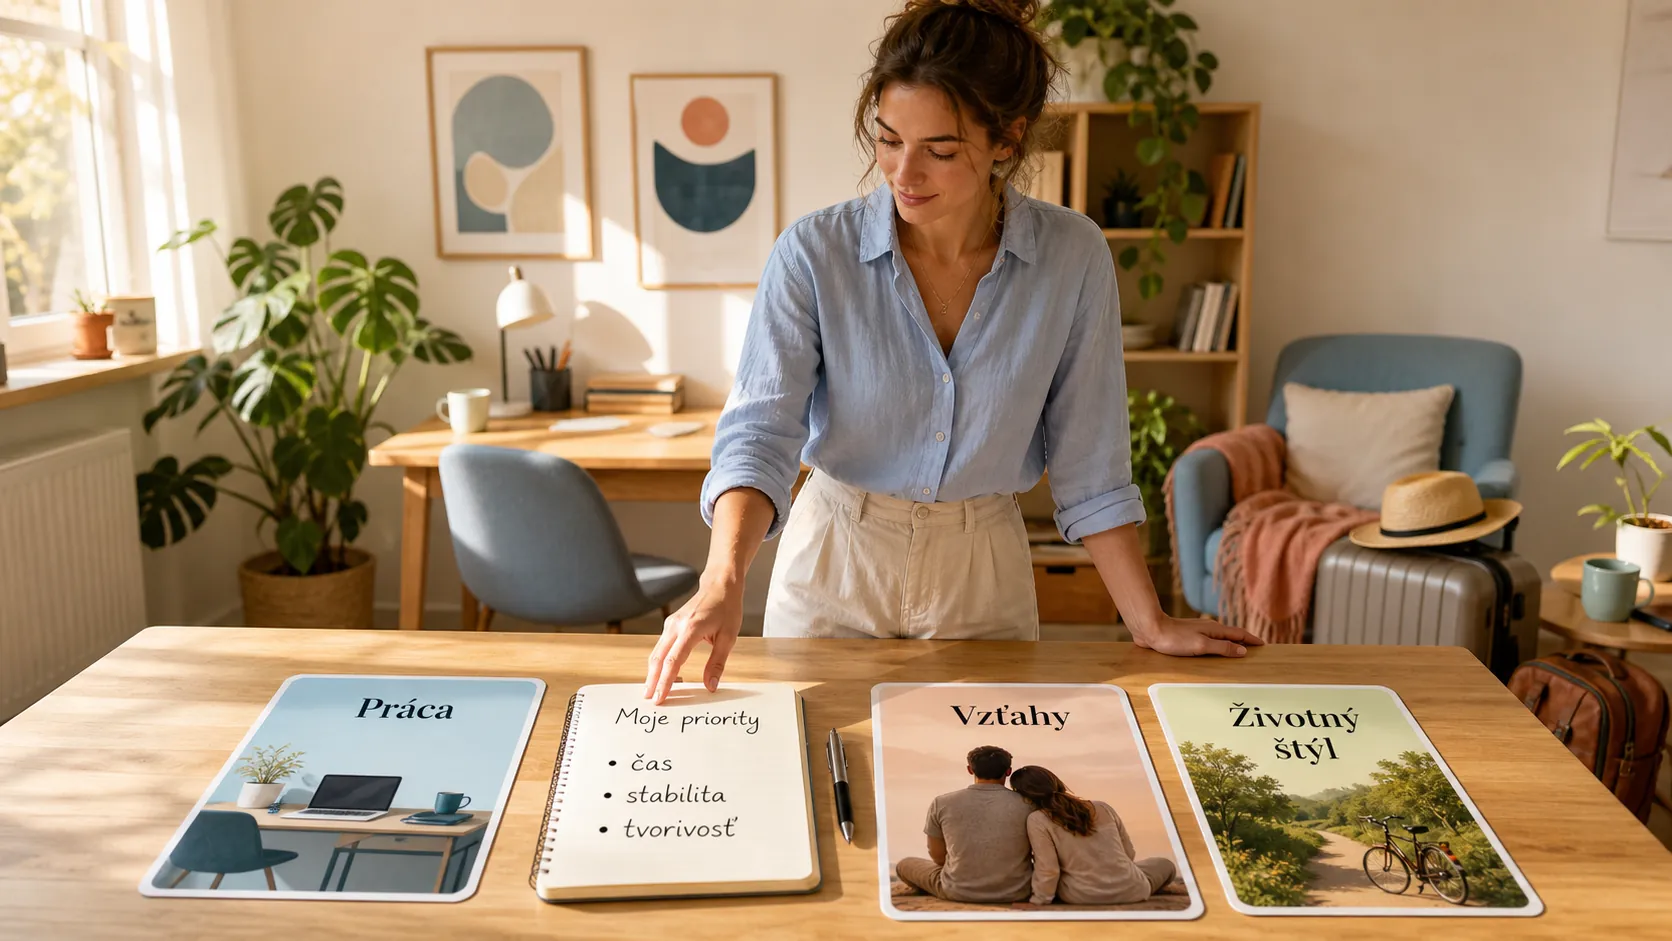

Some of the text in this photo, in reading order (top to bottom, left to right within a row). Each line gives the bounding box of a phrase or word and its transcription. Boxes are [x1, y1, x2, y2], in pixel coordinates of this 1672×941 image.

[355, 697, 454, 720] Práca
[614, 706, 761, 735] Moje priority
[950, 703, 1070, 732] Vzťahy
[1229, 702, 1360, 734] Životný
[631, 753, 673, 772] čas
[1274, 737, 1339, 766] štýl
[626, 783, 726, 804] stabilita
[623, 815, 738, 838] tvorivosť
